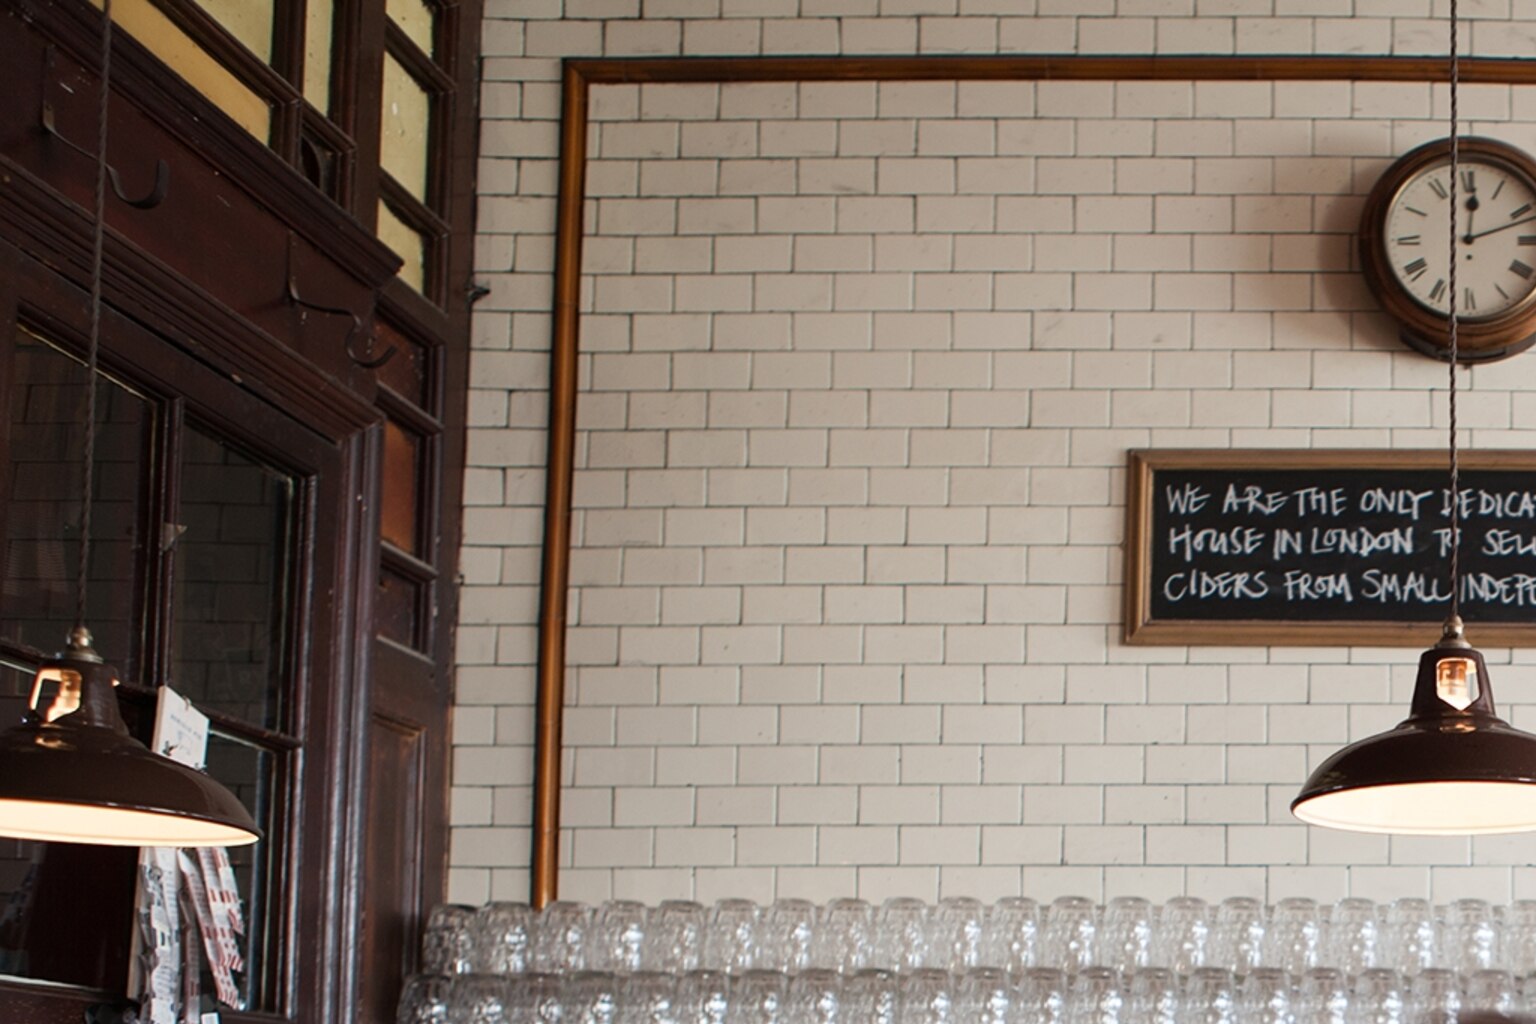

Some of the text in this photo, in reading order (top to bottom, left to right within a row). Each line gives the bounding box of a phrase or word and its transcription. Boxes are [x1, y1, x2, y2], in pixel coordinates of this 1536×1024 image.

[1166, 483, 1212, 514] WE
[1222, 483, 1288, 516] ARE
[1293, 487, 1347, 517] THE
[1360, 487, 1434, 520] ONLY
[1169, 524, 1265, 562] HOUSE
[1273, 528, 1301, 561] IN
[1311, 526, 1413, 557] LONDON
[1164, 569, 1269, 601] CIDERS
[1283, 570, 1353, 602] FROM
[1362, 569, 1452, 603] SMALL
